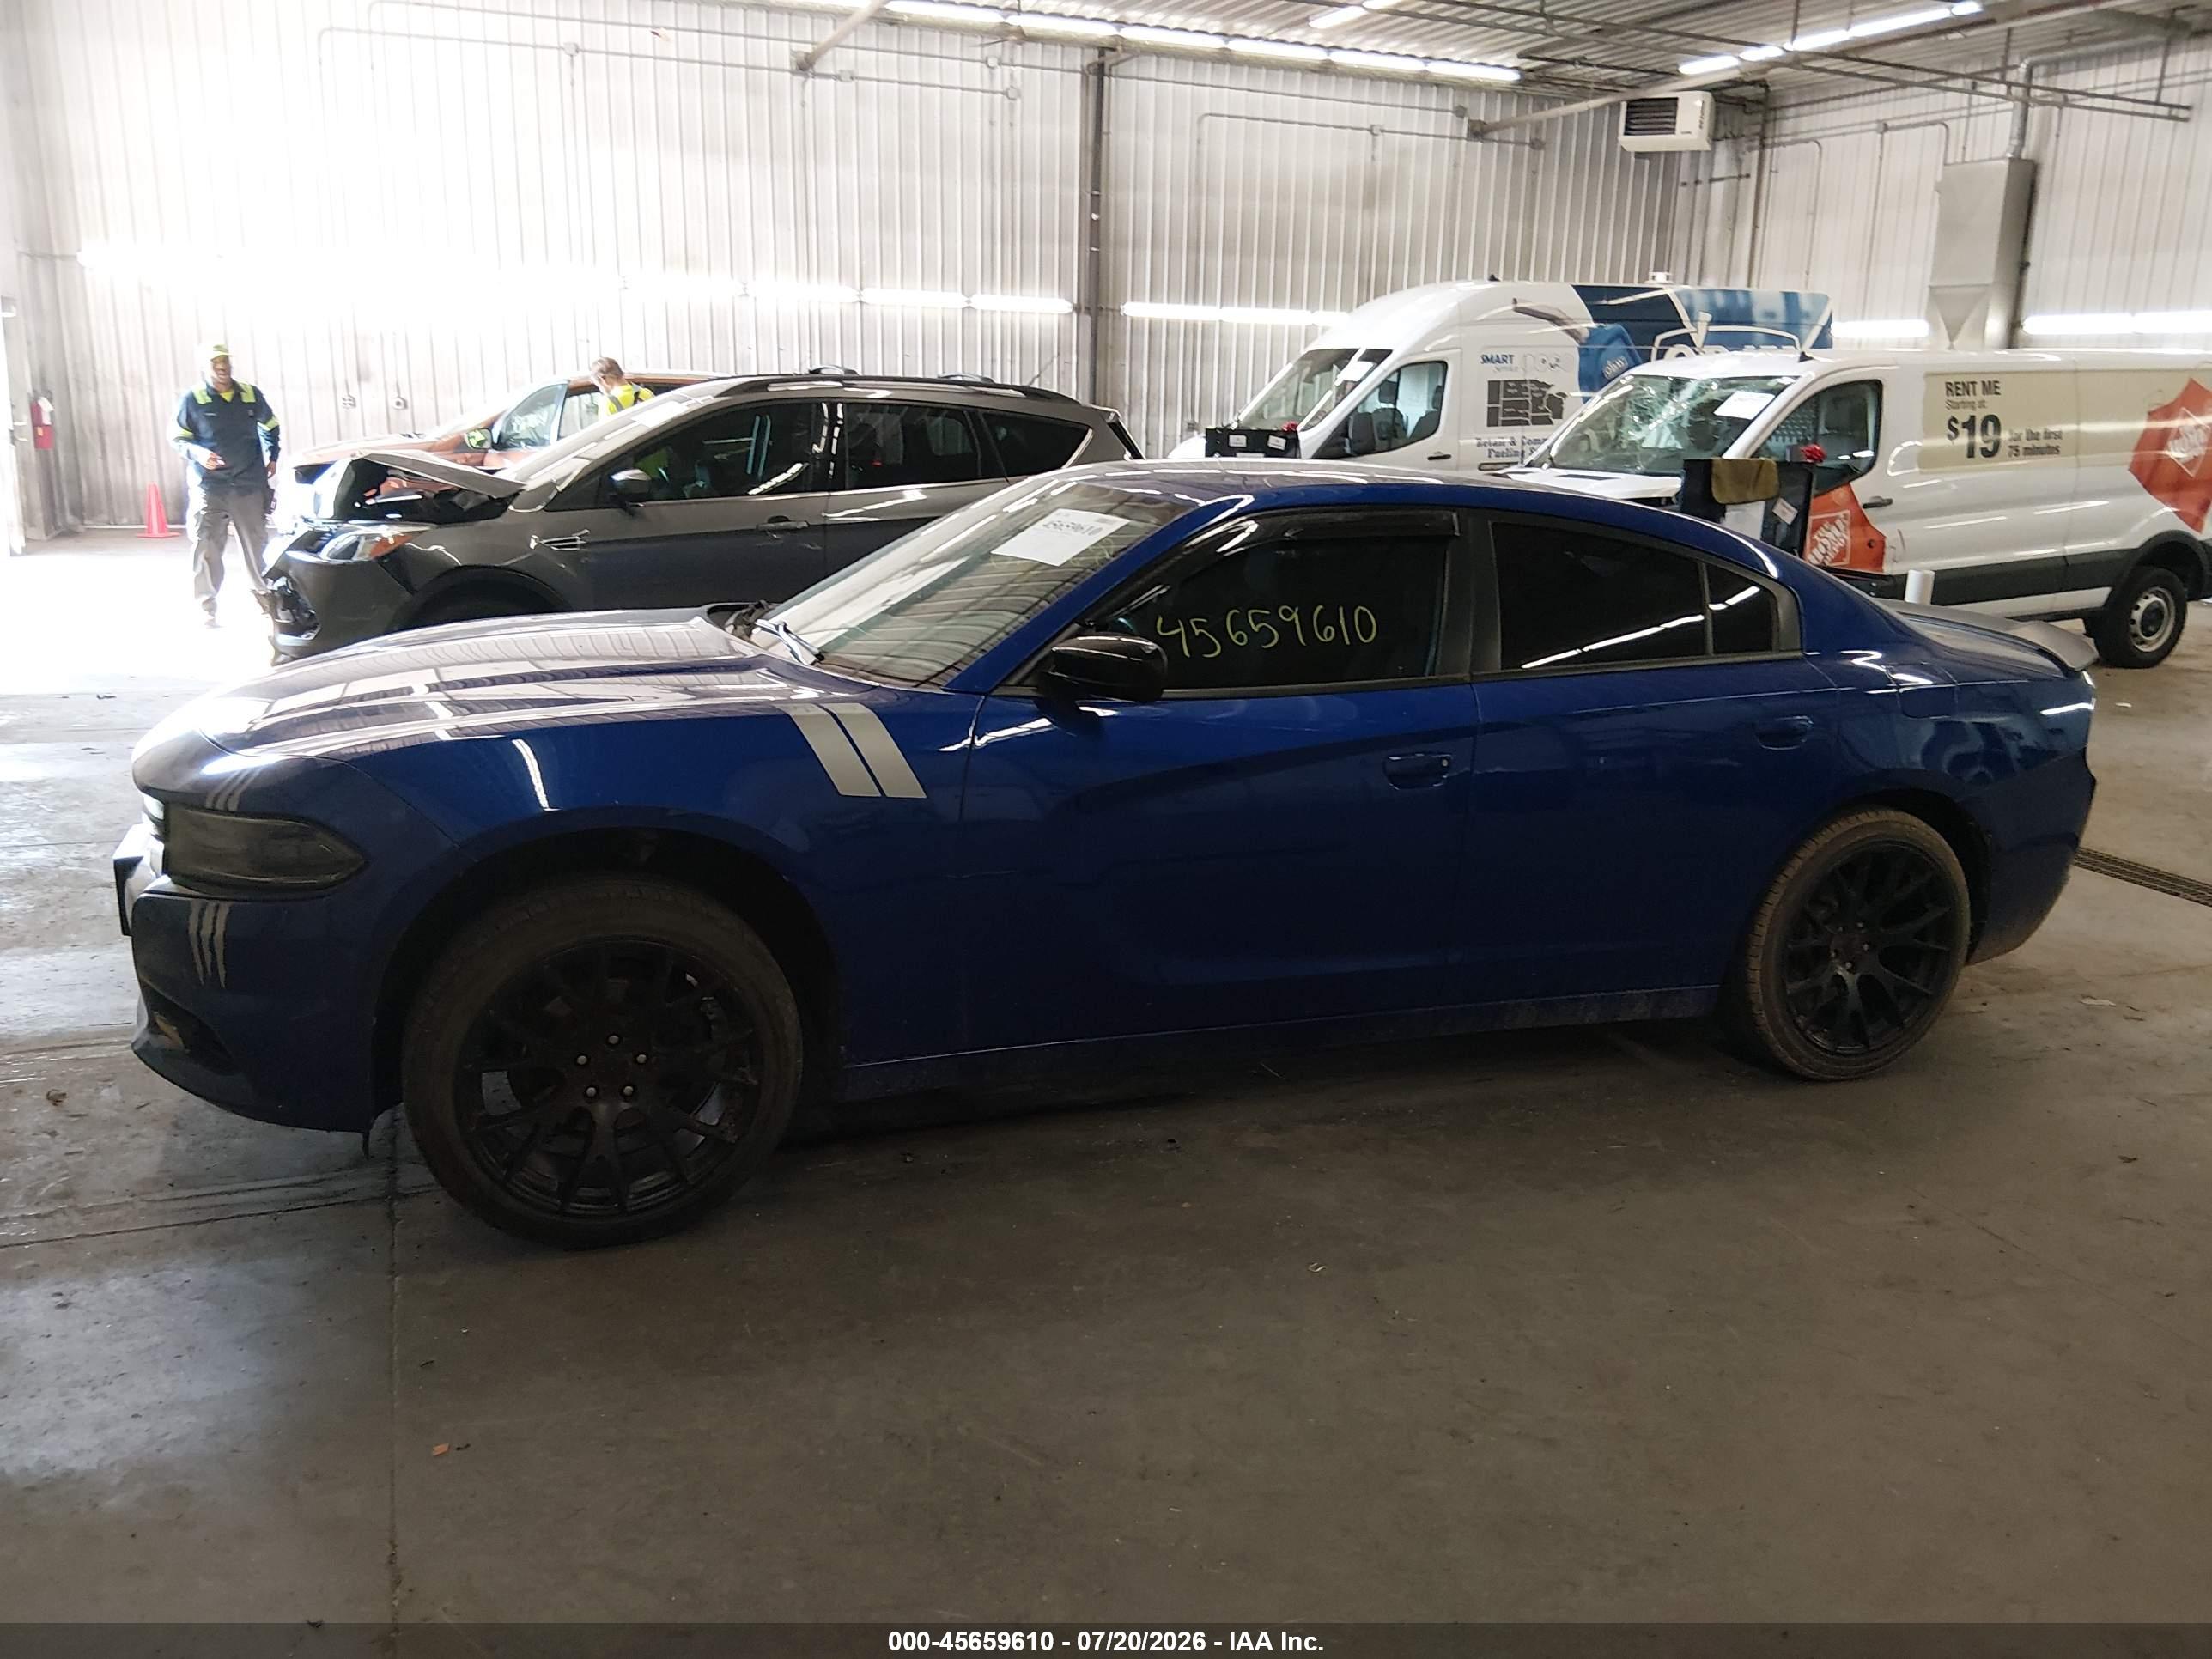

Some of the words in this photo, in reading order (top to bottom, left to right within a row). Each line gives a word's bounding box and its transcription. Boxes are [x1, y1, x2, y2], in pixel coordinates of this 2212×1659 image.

[1480, 354, 1515, 364] SMART
[1945, 381, 1978, 397] RENT
[1981, 380, 2002, 395] ME
[1946, 414, 2002, 459] $19
[2022, 443, 2061, 456] minutes
[1156, 605, 1377, 658] 45659610
